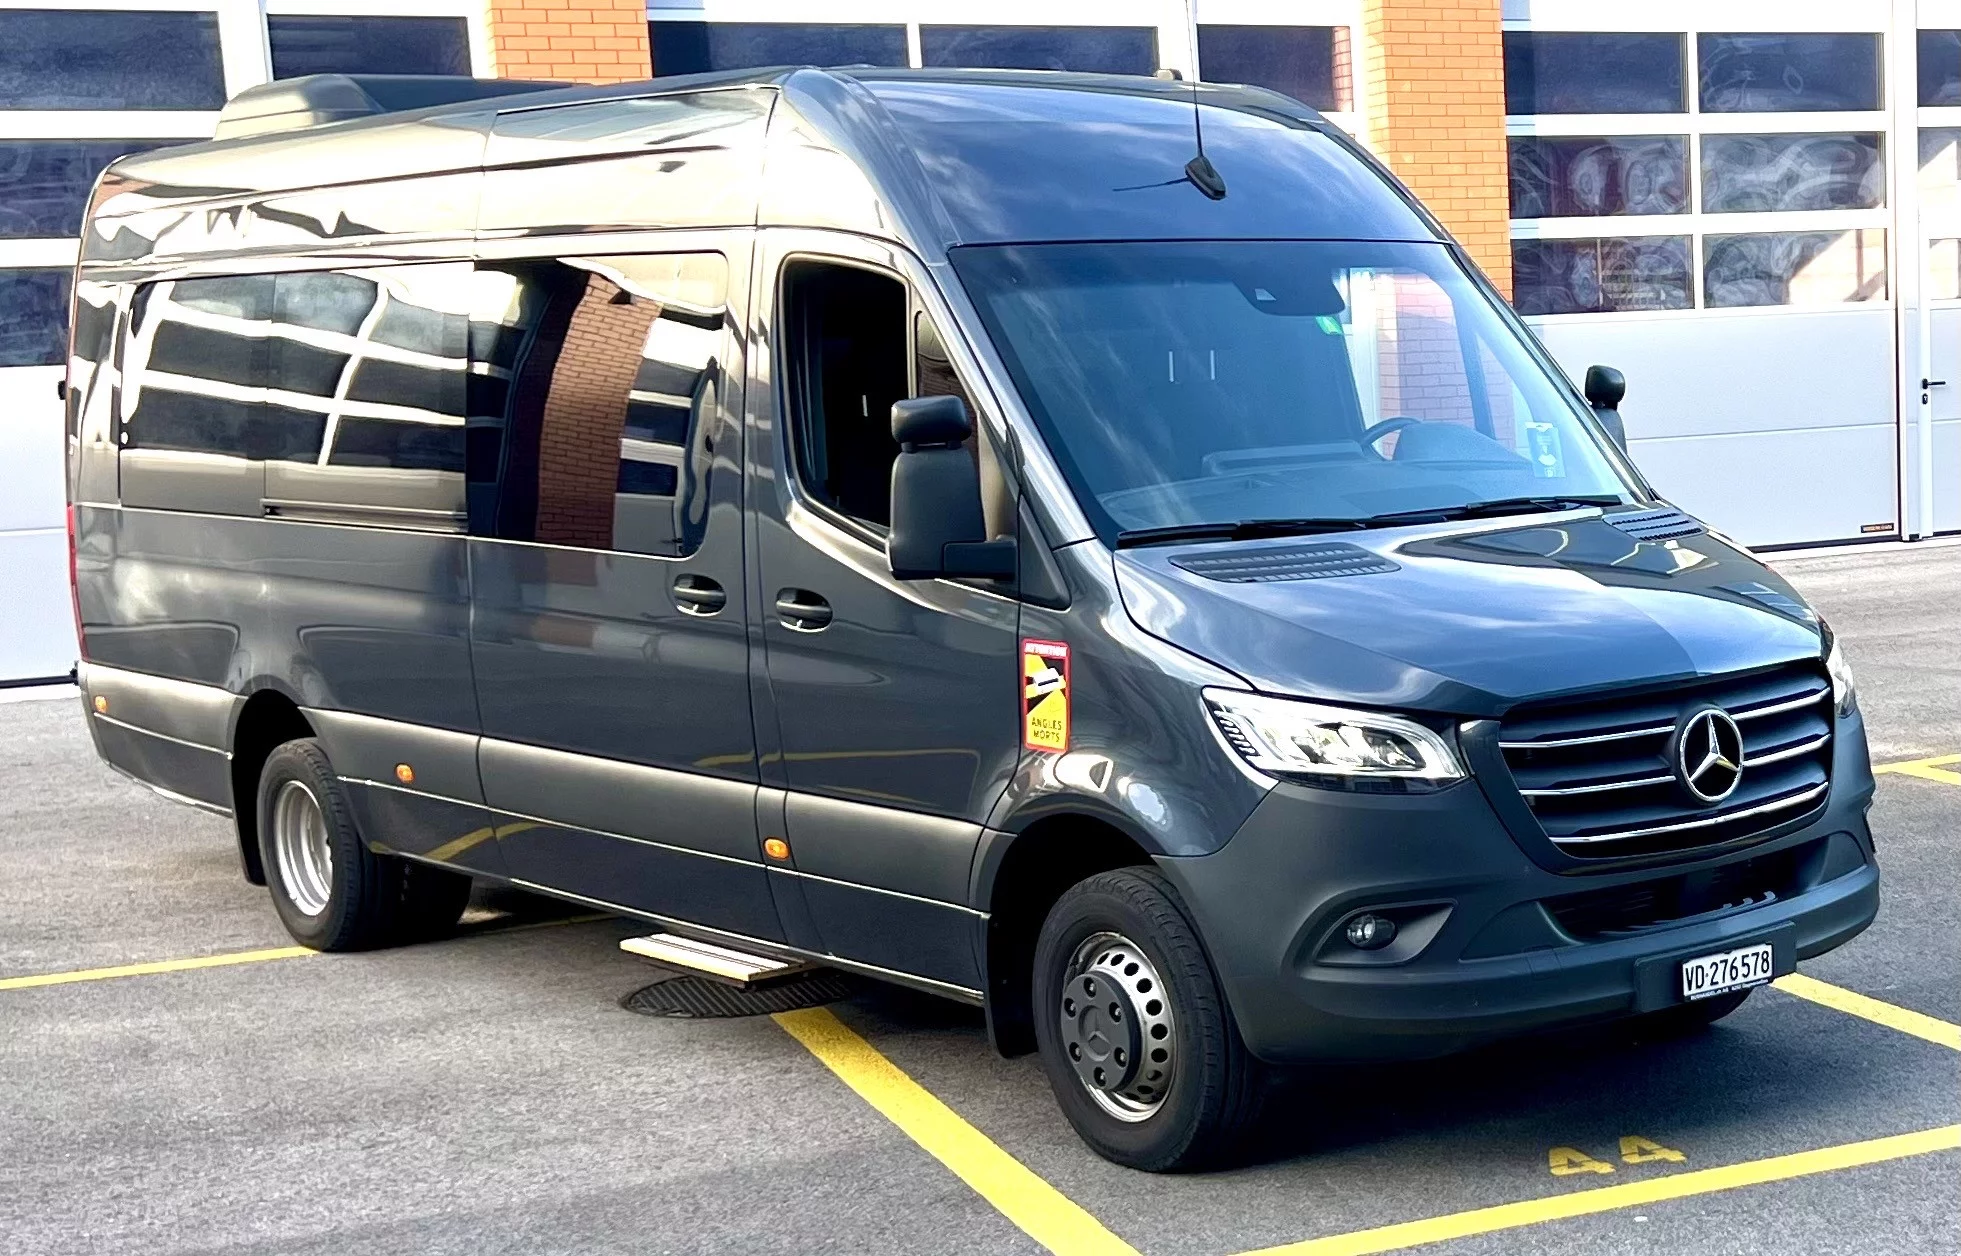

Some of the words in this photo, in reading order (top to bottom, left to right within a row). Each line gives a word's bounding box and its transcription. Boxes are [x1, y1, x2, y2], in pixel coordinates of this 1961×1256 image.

[1031, 717, 1062, 731] ANGLES
[1033, 730, 1060, 743] MORTS
[1549, 1135, 1688, 1176] 44
